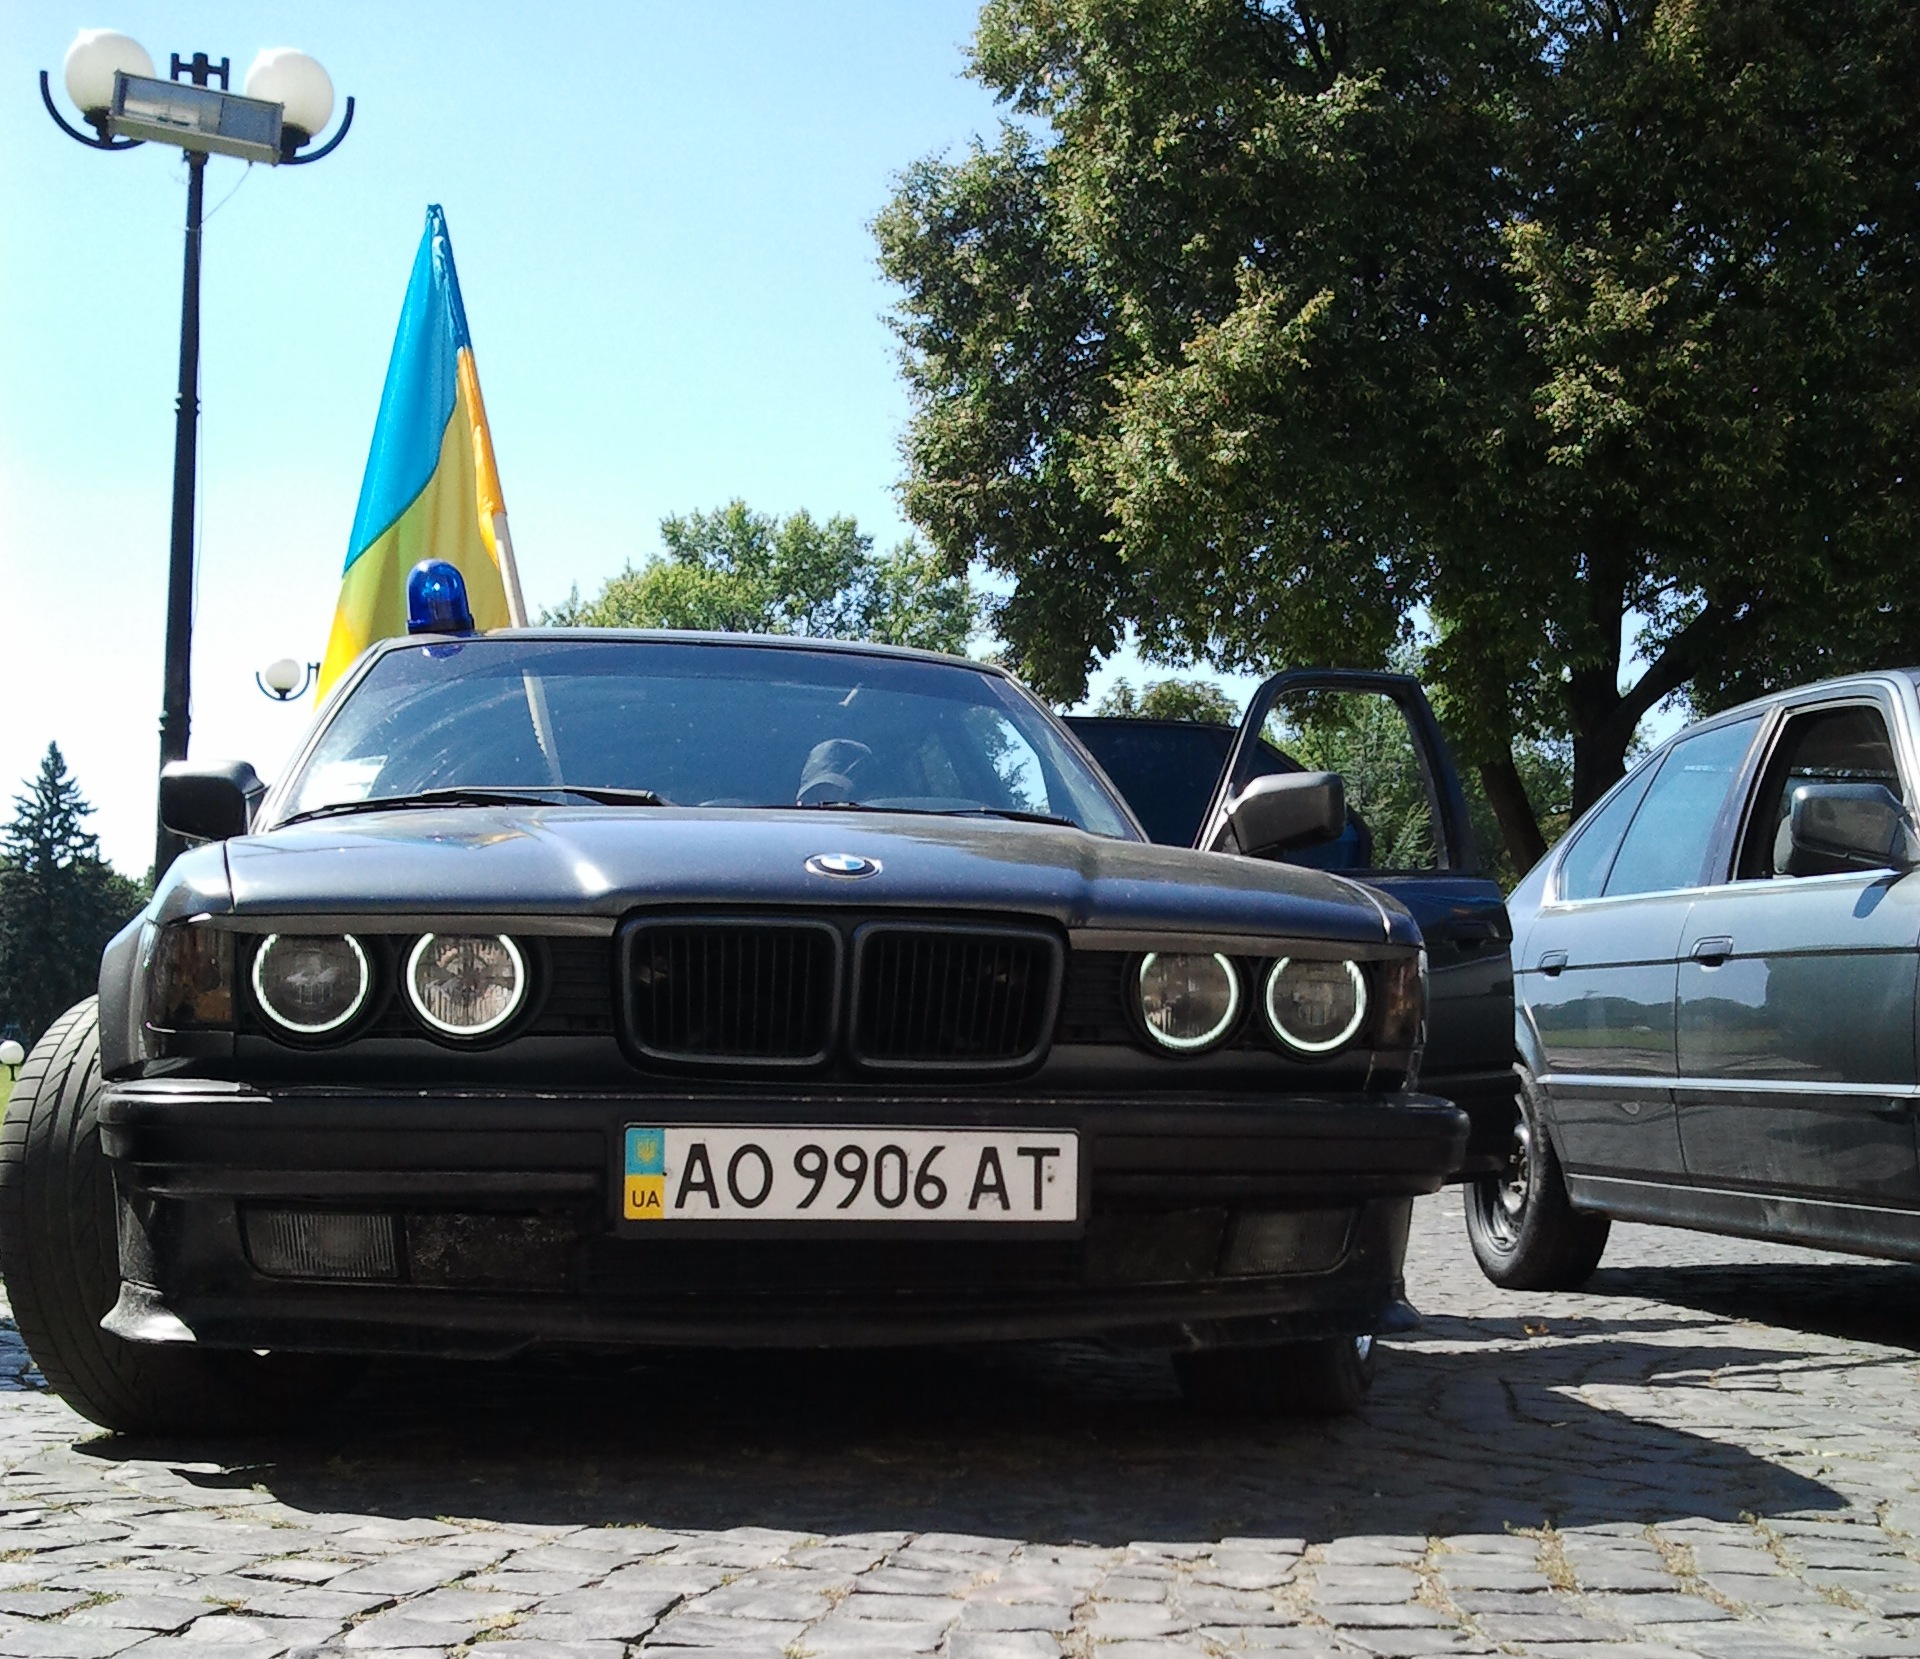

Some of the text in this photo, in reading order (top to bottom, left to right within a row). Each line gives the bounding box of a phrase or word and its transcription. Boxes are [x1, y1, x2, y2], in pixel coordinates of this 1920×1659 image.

[674, 1143, 1061, 1211] AO 9906 AT
[631, 1190, 661, 1208] UA
